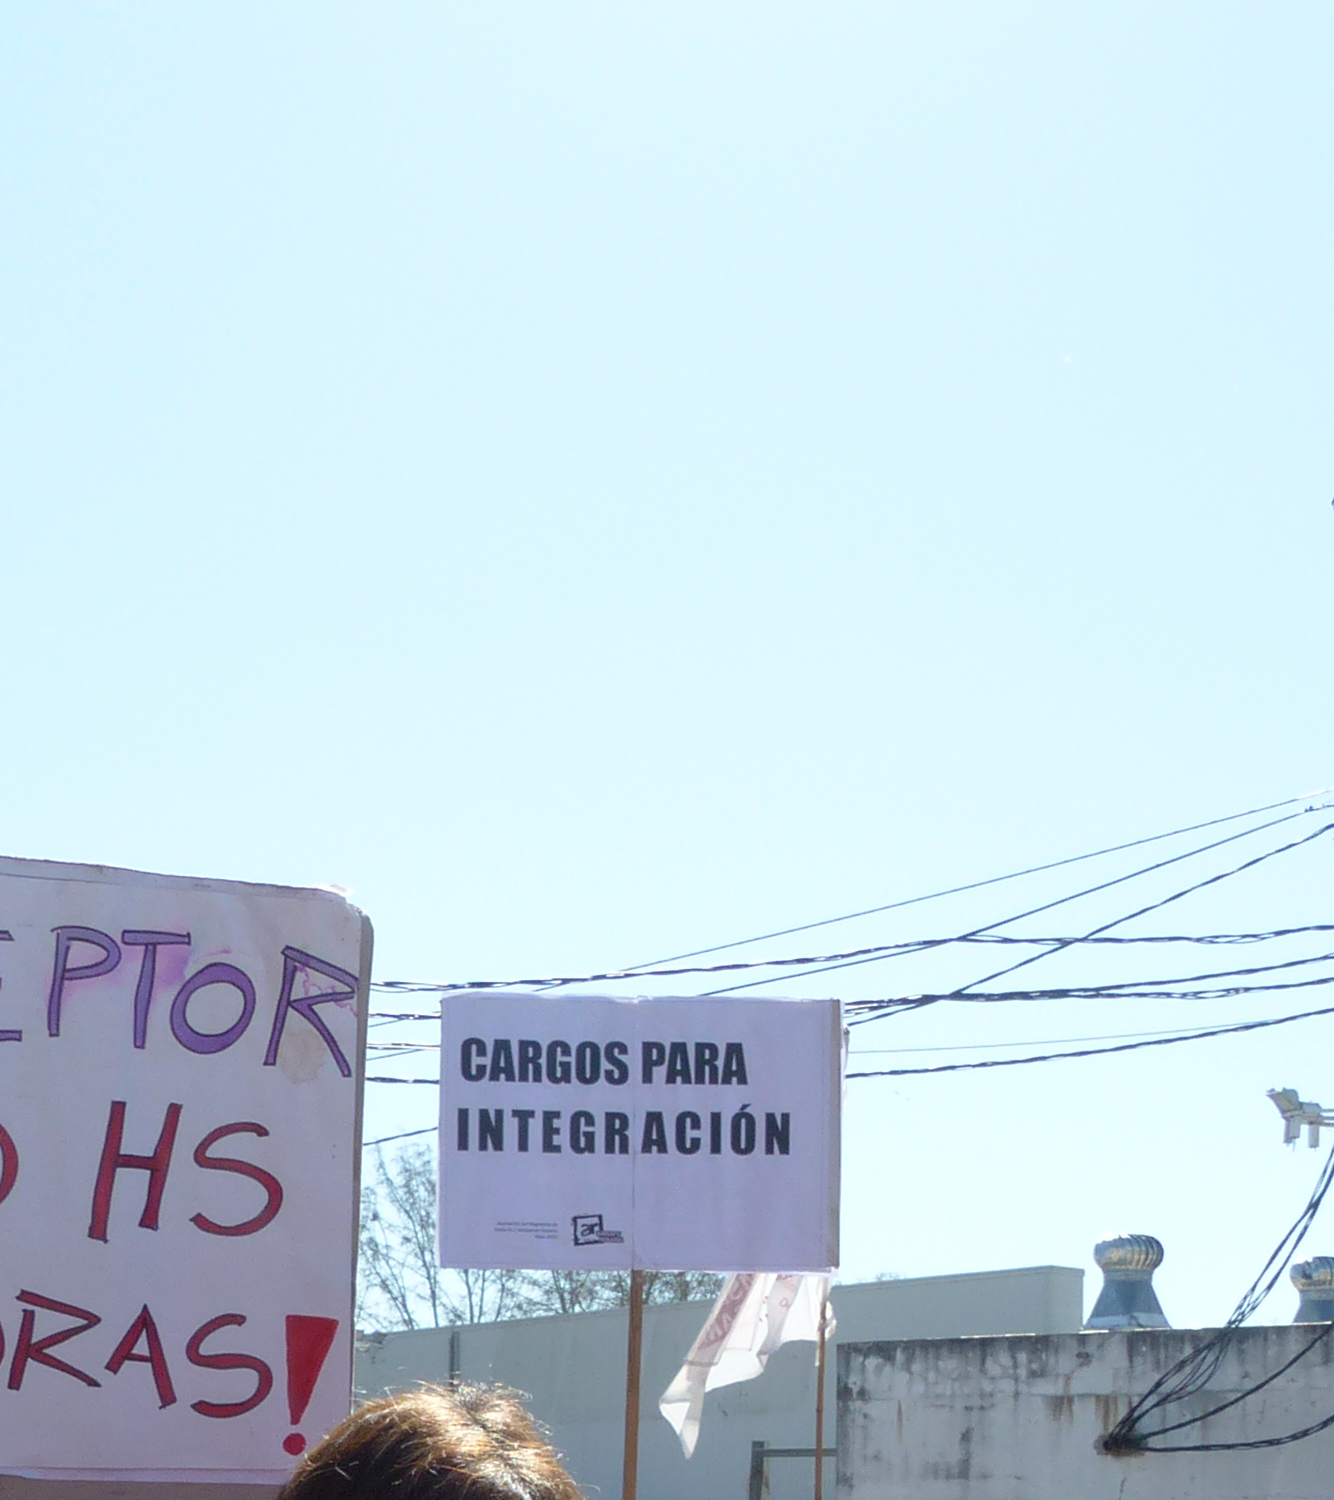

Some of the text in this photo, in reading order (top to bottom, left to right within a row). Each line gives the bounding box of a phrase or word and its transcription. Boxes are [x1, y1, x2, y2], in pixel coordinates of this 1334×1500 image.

[460, 1036, 749, 1086] CARGOS PARA
[456, 1103, 792, 1156] INTEGRACIÓN
[87, 1099, 285, 1244] HS
